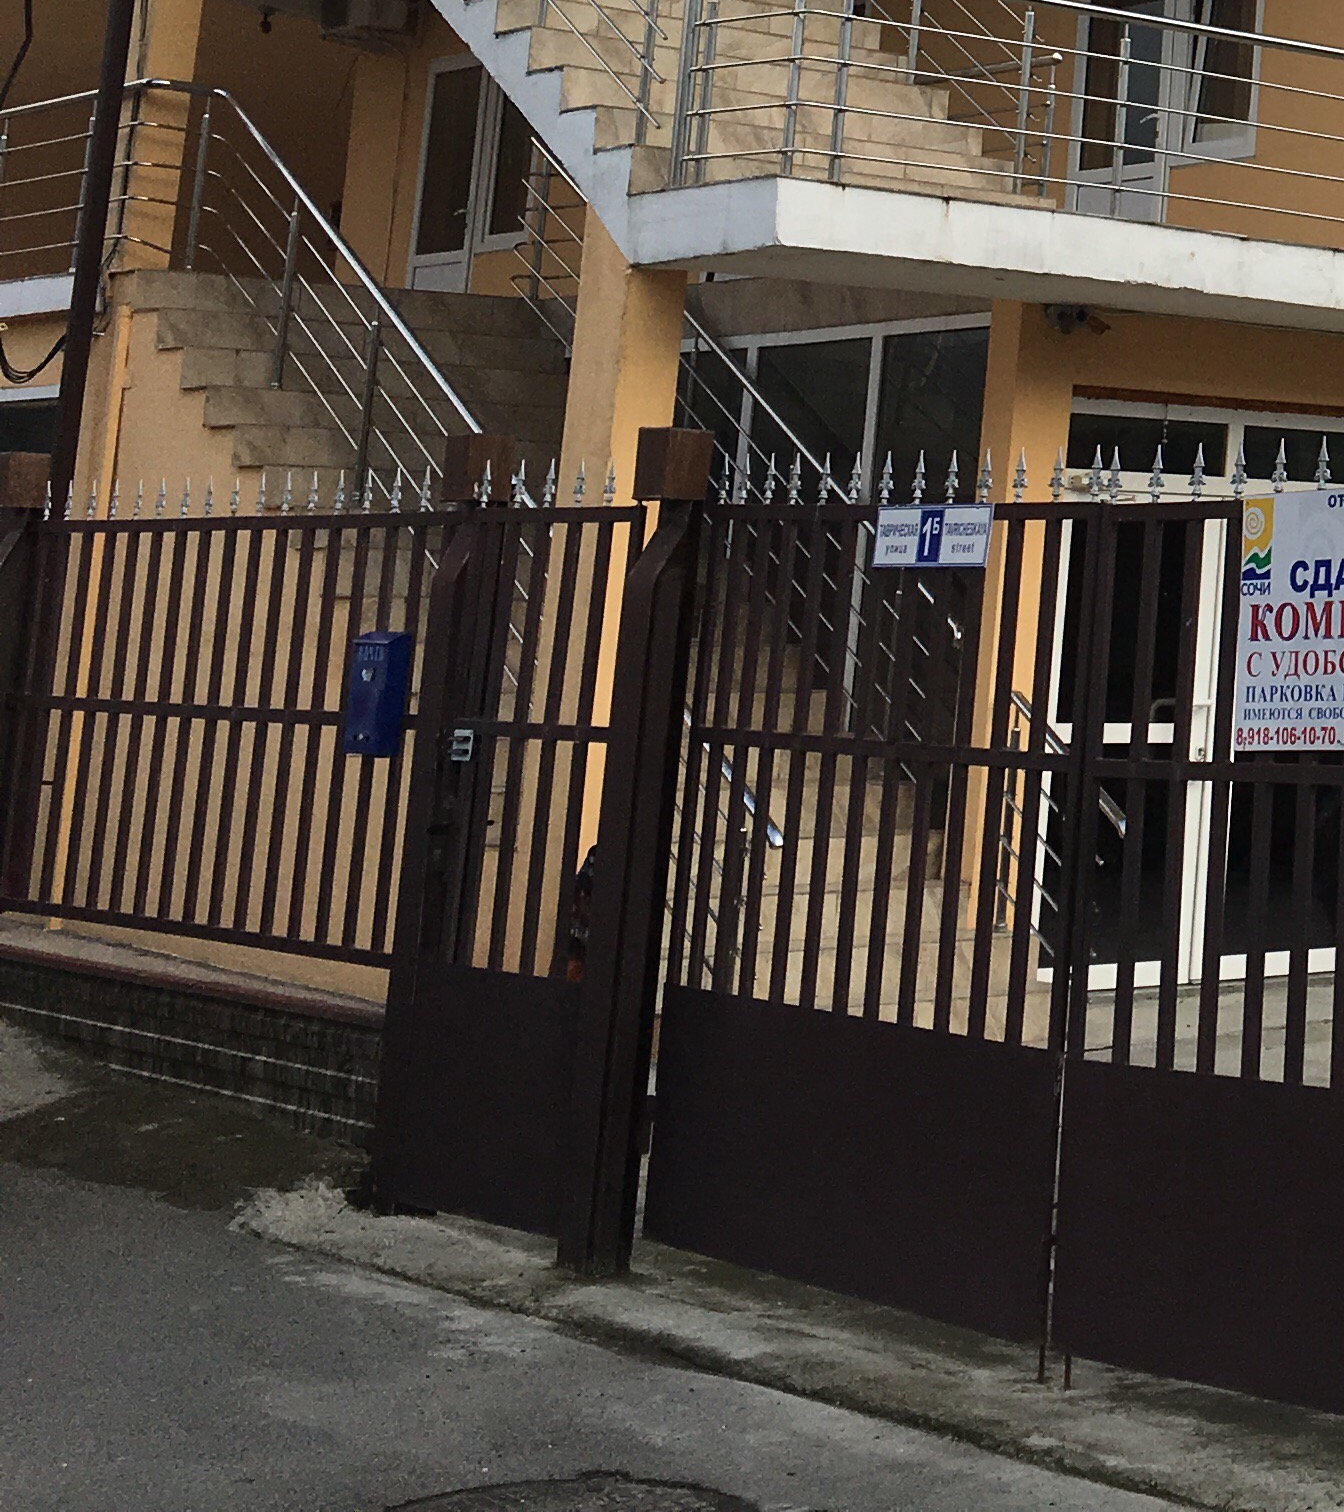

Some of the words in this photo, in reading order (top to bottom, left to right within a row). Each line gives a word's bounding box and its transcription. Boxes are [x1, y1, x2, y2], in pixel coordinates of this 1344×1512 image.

[1240, 580, 1271, 596] СОЧИ
[1247, 651, 1263, 677] С
[1246, 684, 1336, 703] ПАРКОВКА
[1244, 707, 1303, 721] ИМЕЮТСЯ
